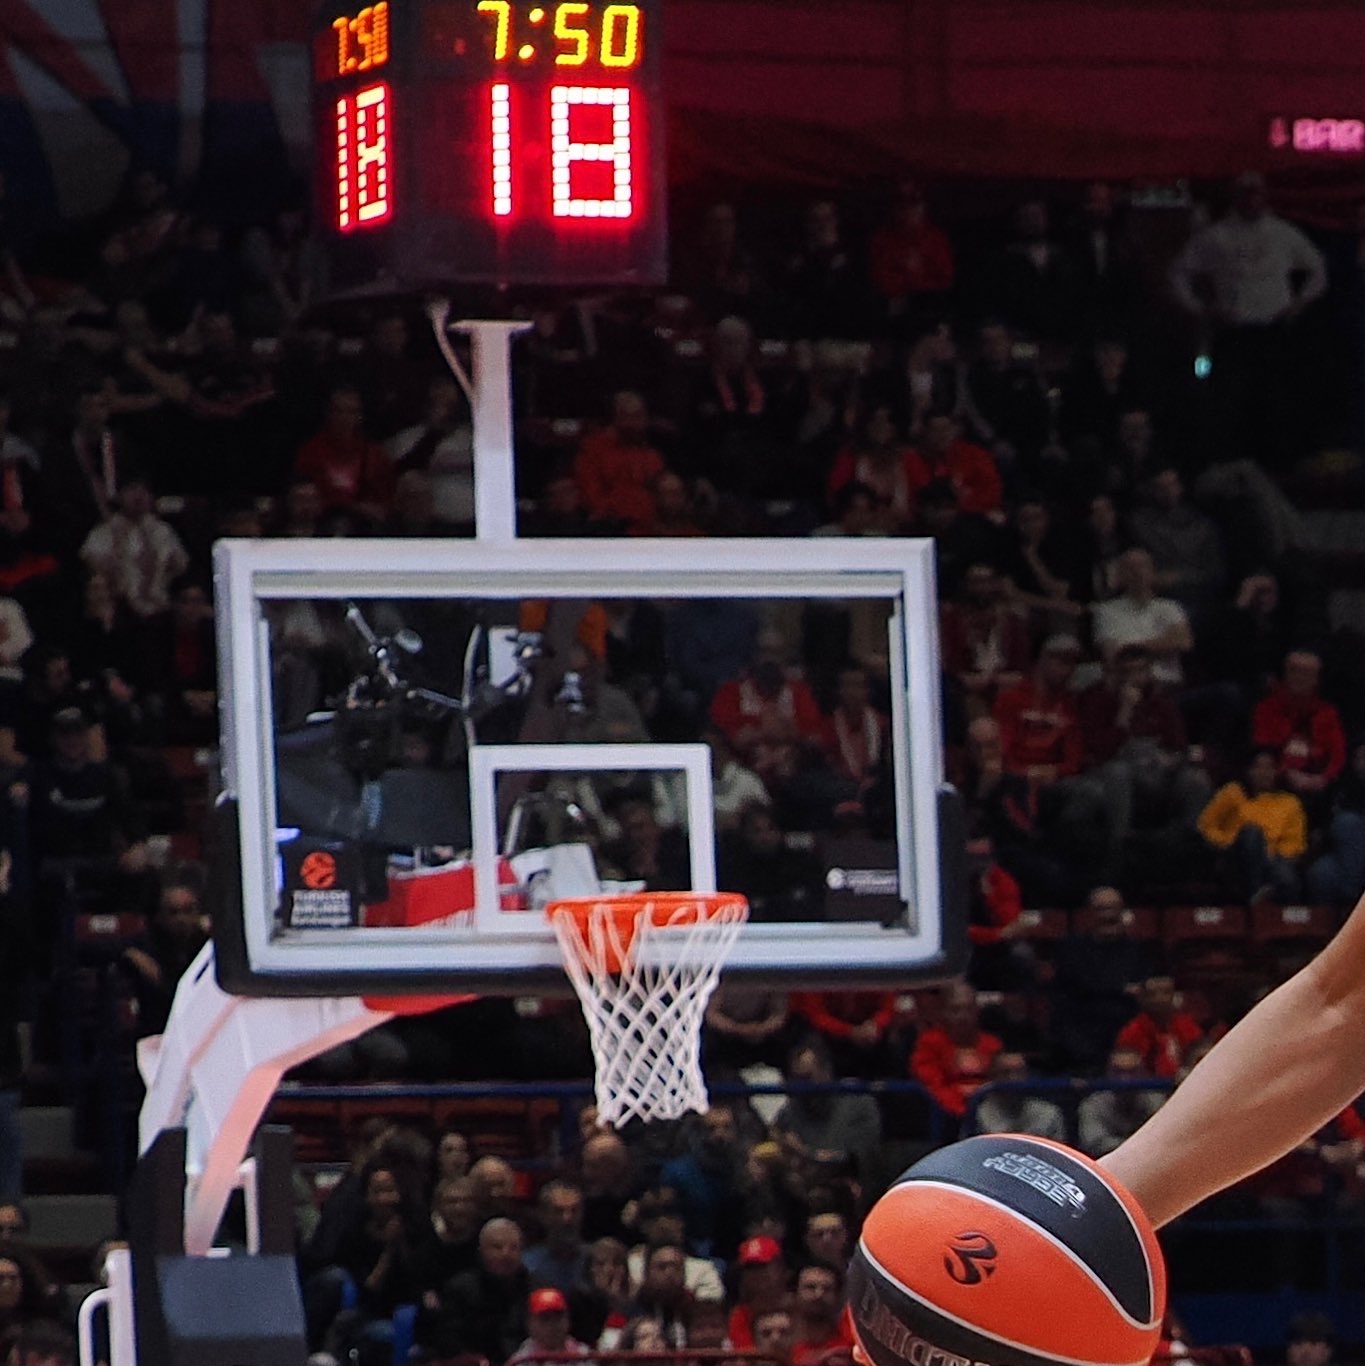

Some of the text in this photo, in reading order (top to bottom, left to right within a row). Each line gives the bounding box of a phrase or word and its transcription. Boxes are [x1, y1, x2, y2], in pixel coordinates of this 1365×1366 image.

[478, 0, 640, 66] 7:50
[337, 86, 388, 229] 18
[492, 85, 632, 217] 18
[1293, 118, 1365, 150] BAR
